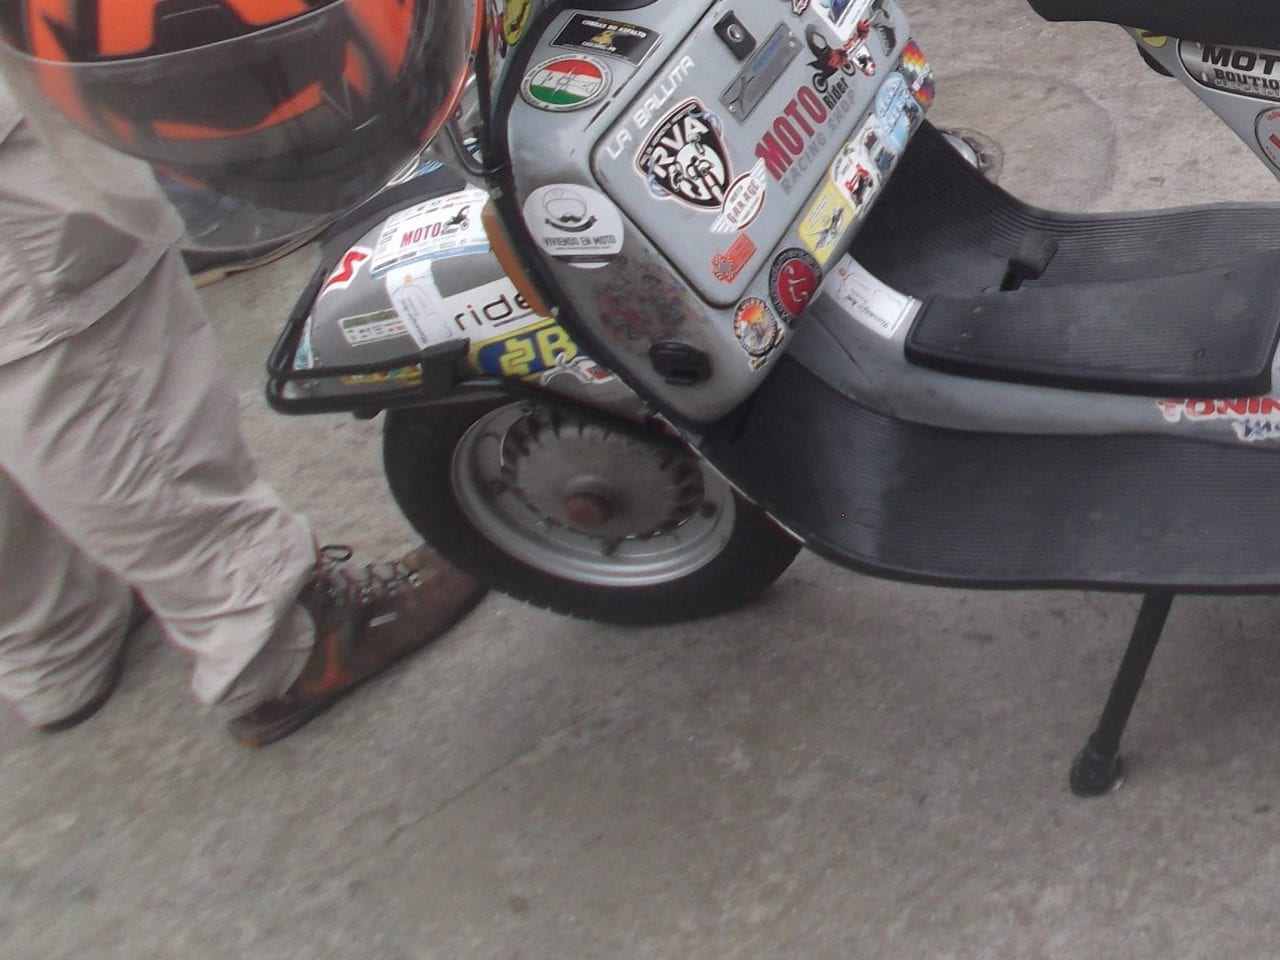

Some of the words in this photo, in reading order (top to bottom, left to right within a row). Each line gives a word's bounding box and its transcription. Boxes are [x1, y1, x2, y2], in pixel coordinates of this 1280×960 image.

[605, 127, 634, 161] LA
[754, 84, 828, 182] MOTO
[822, 76, 851, 111] Rider
[781, 130, 828, 194] RACING
[725, 176, 761, 224] GARAGE
[400, 221, 442, 249] MOTO
